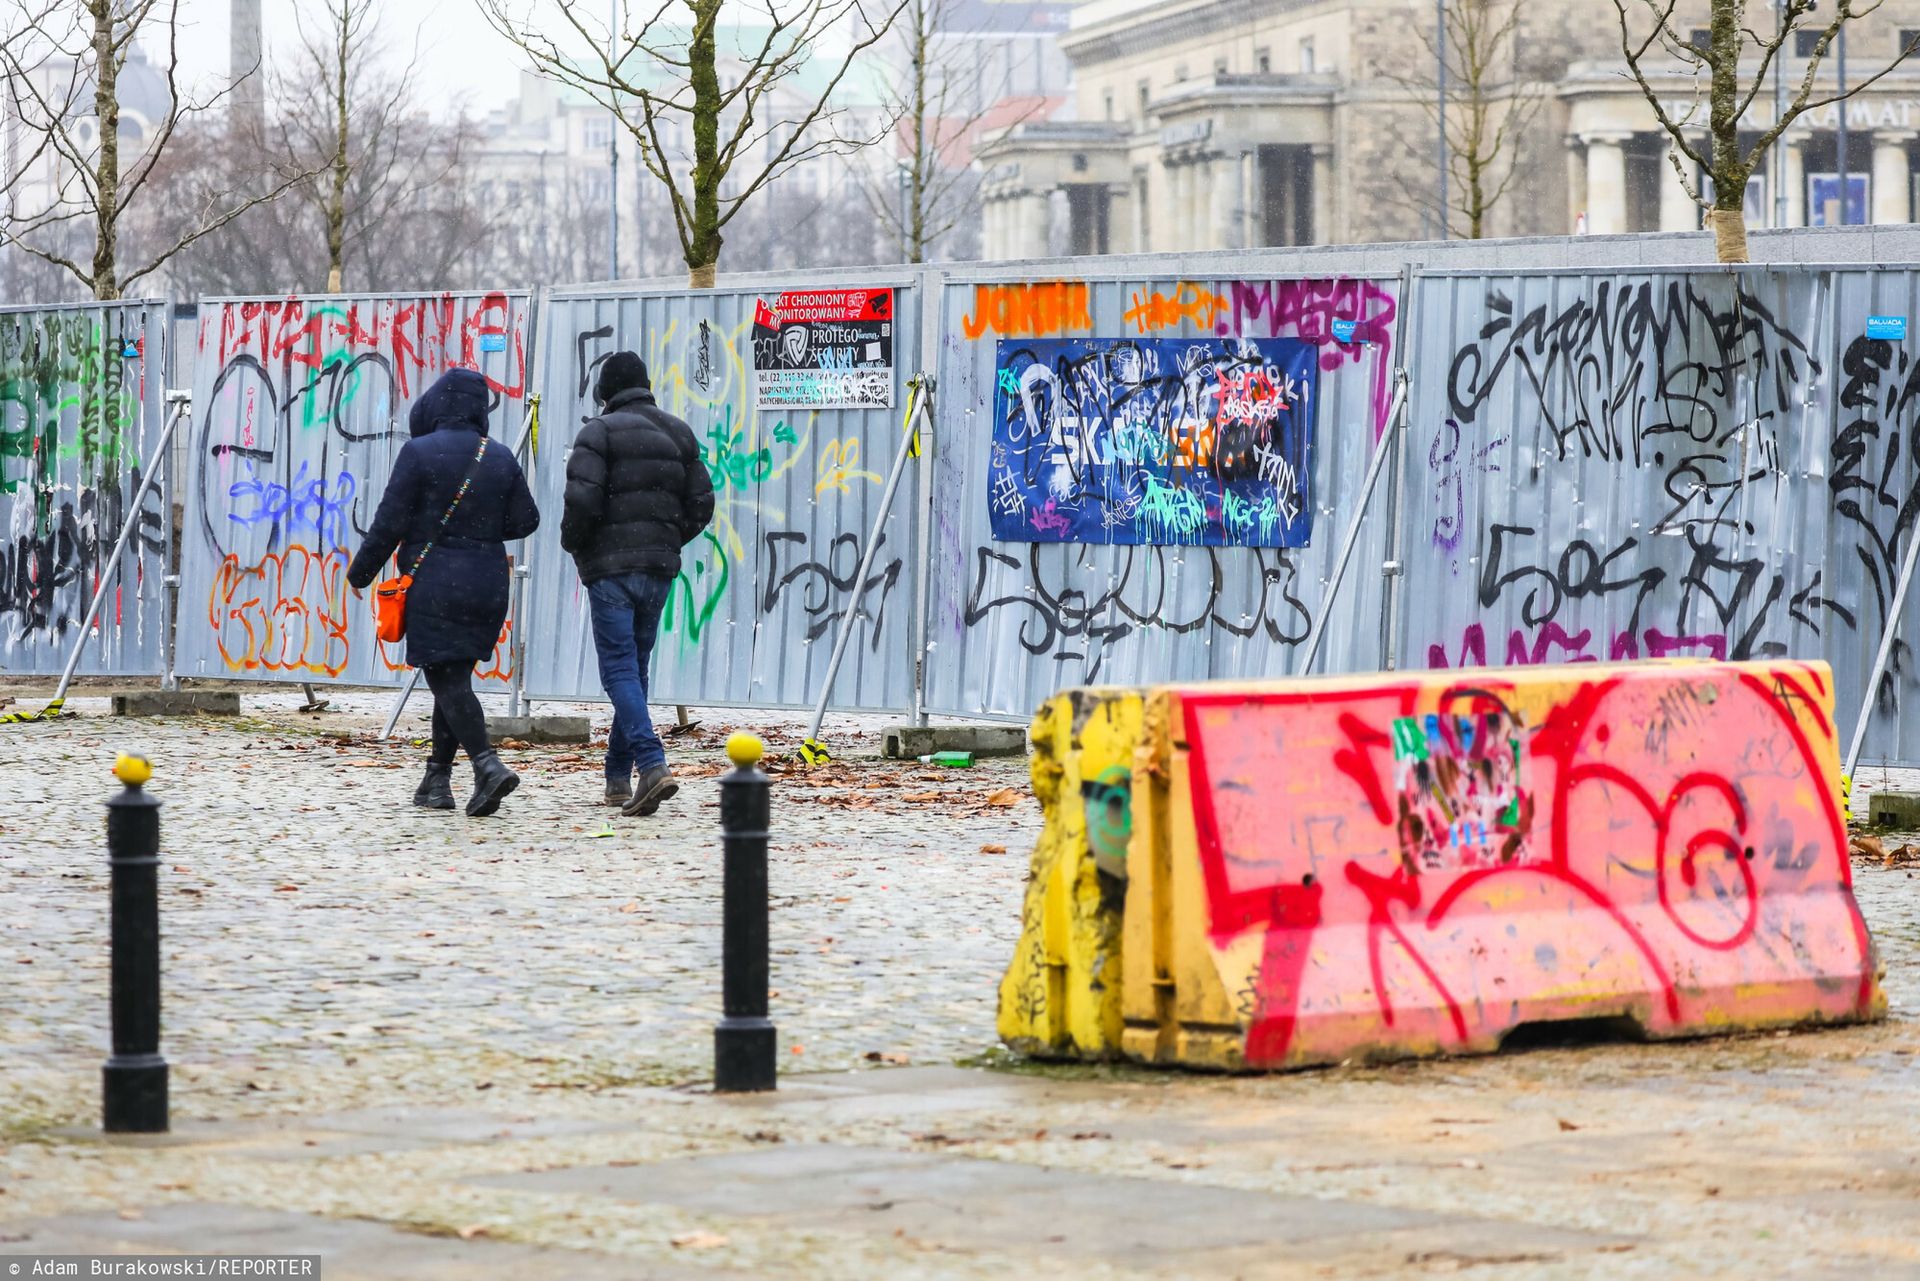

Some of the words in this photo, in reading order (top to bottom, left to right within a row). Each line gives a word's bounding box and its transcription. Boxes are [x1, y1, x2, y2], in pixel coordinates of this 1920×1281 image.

[791, 294, 846, 306] CHRONIONY
[812, 328, 858, 343] PROTEGO
[759, 373, 768, 382] tel.
